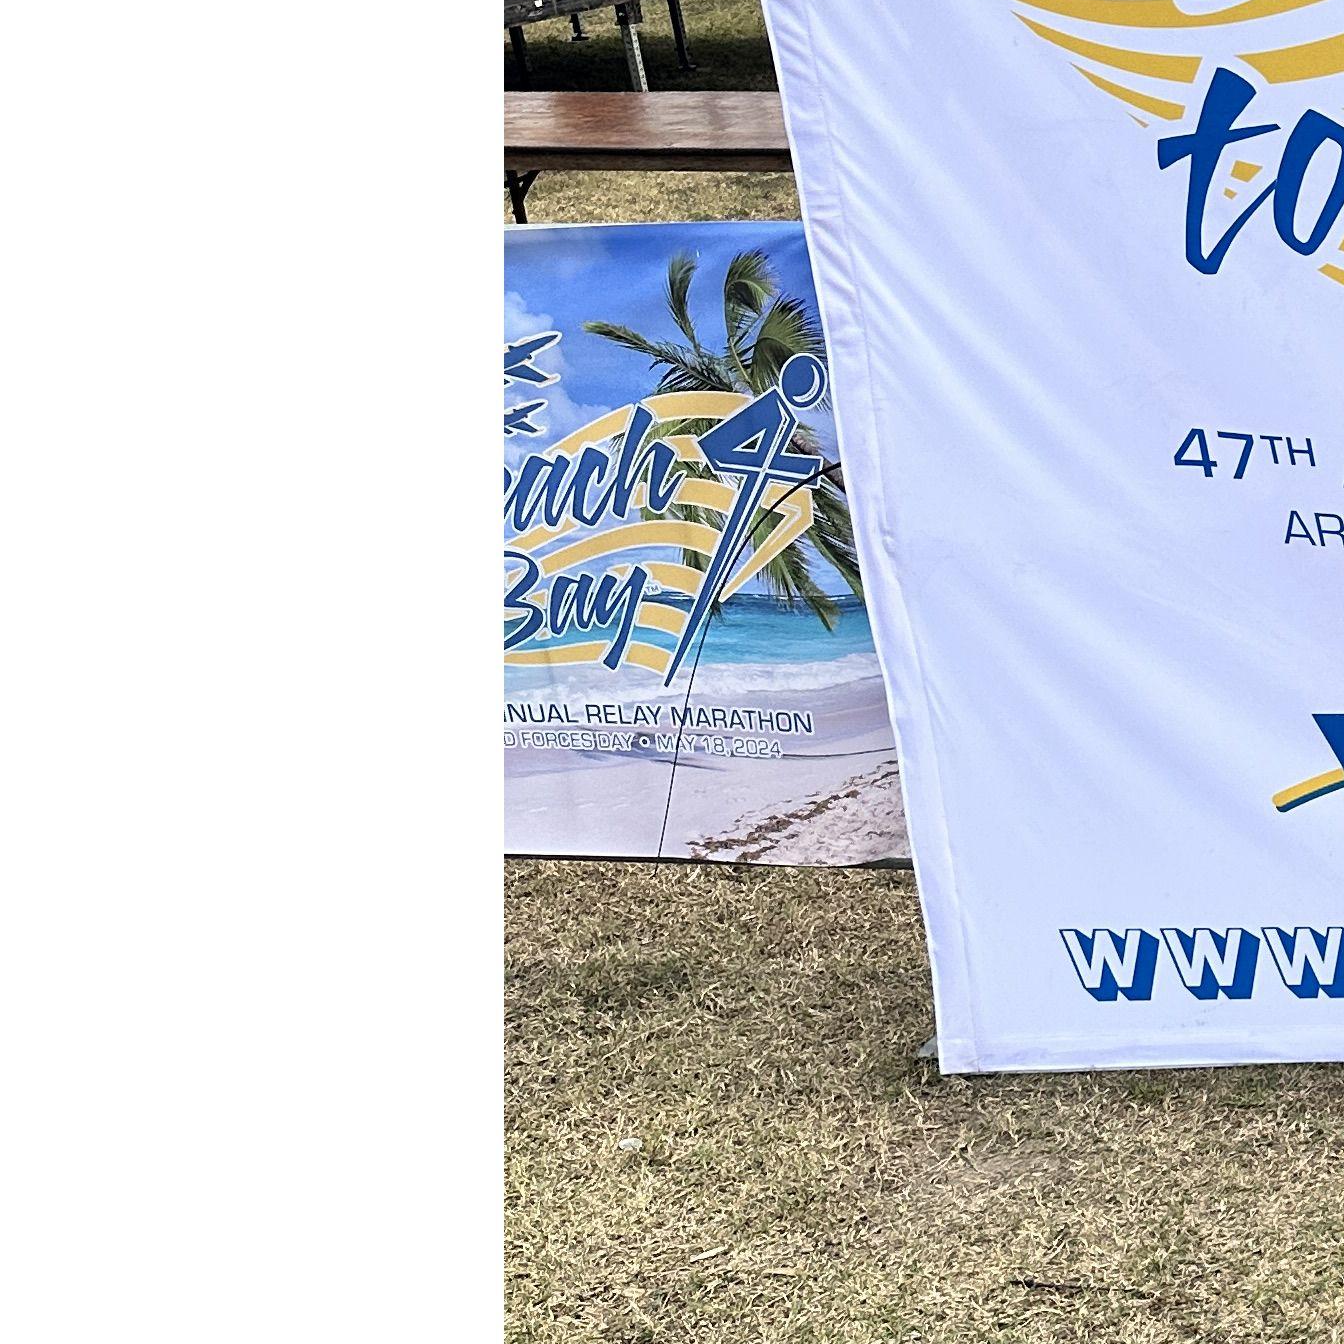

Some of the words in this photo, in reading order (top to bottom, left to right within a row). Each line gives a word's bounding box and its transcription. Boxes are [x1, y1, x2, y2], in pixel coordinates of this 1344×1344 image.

[504, 403, 687, 532] ach
[1173, 428, 1316, 480] 47TH
[504, 703, 580, 723] NUAL
[585, 704, 662, 725] RELAY
[670, 706, 813, 733] MARATHON
[521, 731, 593, 748] FORCES
[598, 733, 633, 750] DAY
[656, 735, 695, 752] MAY
[733, 738, 782, 756] 2024
